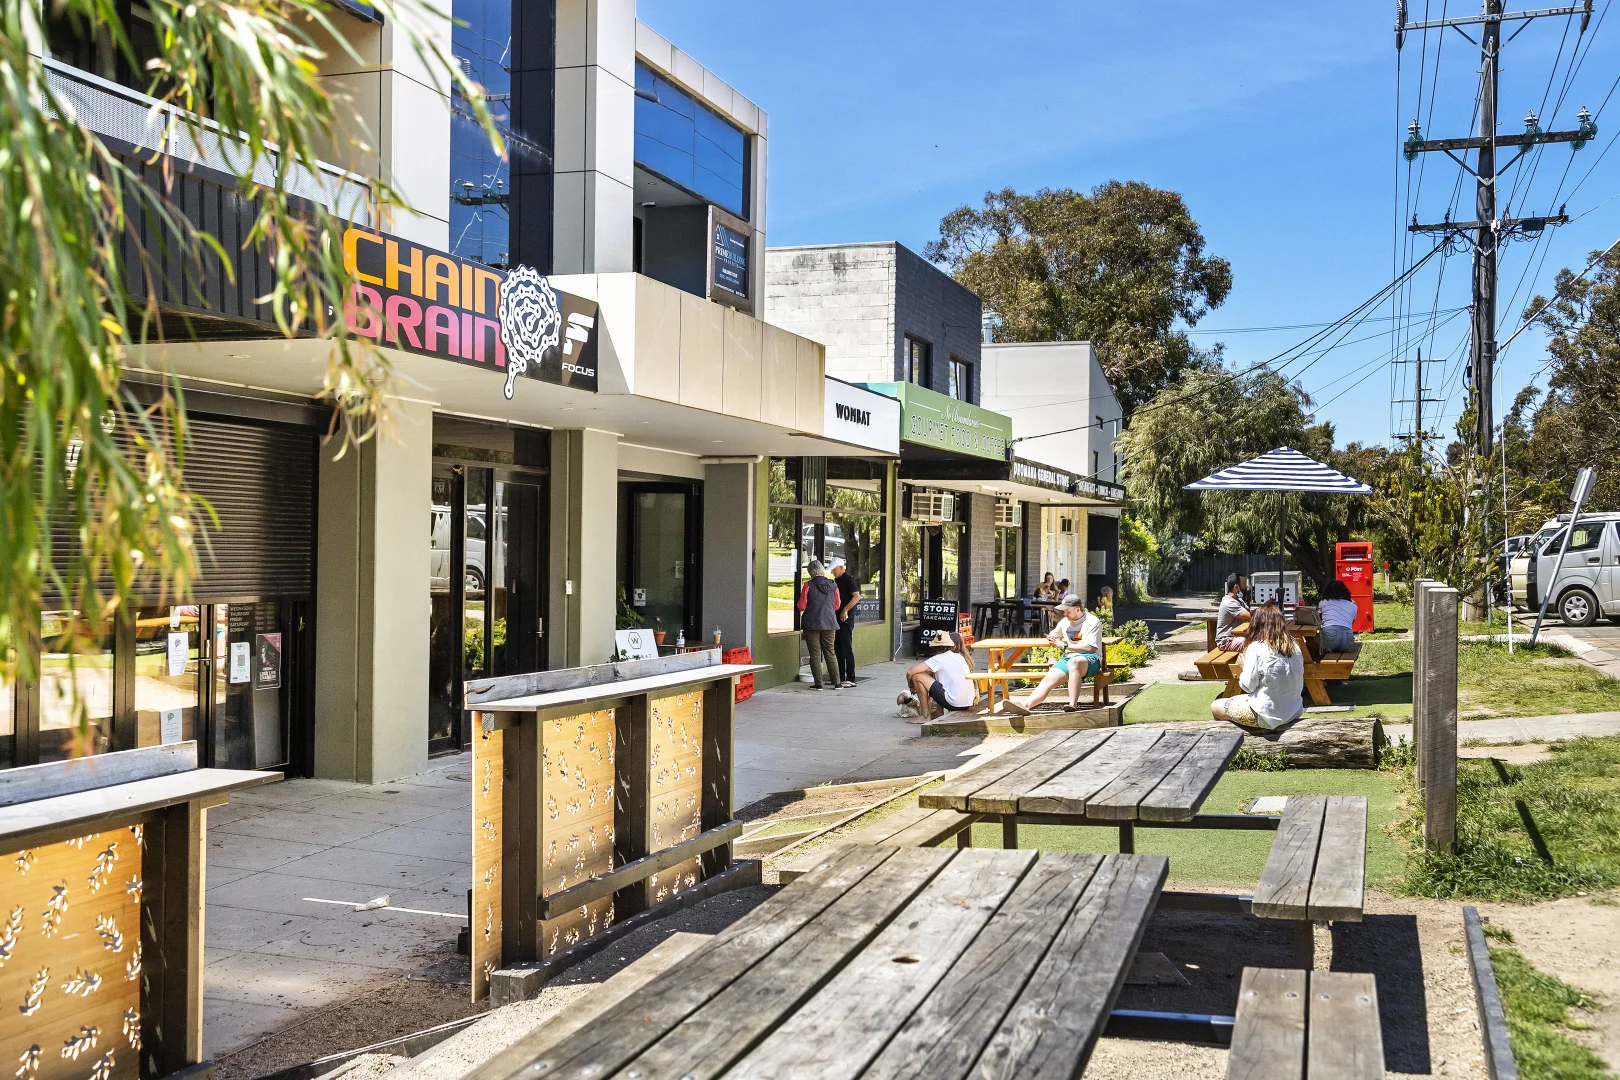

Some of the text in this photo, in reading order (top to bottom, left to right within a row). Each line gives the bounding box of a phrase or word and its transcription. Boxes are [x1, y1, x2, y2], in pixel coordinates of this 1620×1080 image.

[343, 228, 502, 319] CHAIN
[343, 283, 505, 367] BRAIN
[561, 362, 595, 377] FOCUS
[835, 402, 871, 427] WOMBAT
[911, 415, 949, 444] GOURMET
[950, 425, 971, 448] FOOD
[981, 433, 1005, 456] COFFEE
[1038, 468, 1056, 484] GENERAL
[1056, 473, 1070, 488] STORE
[923, 605, 956, 613] STORE
